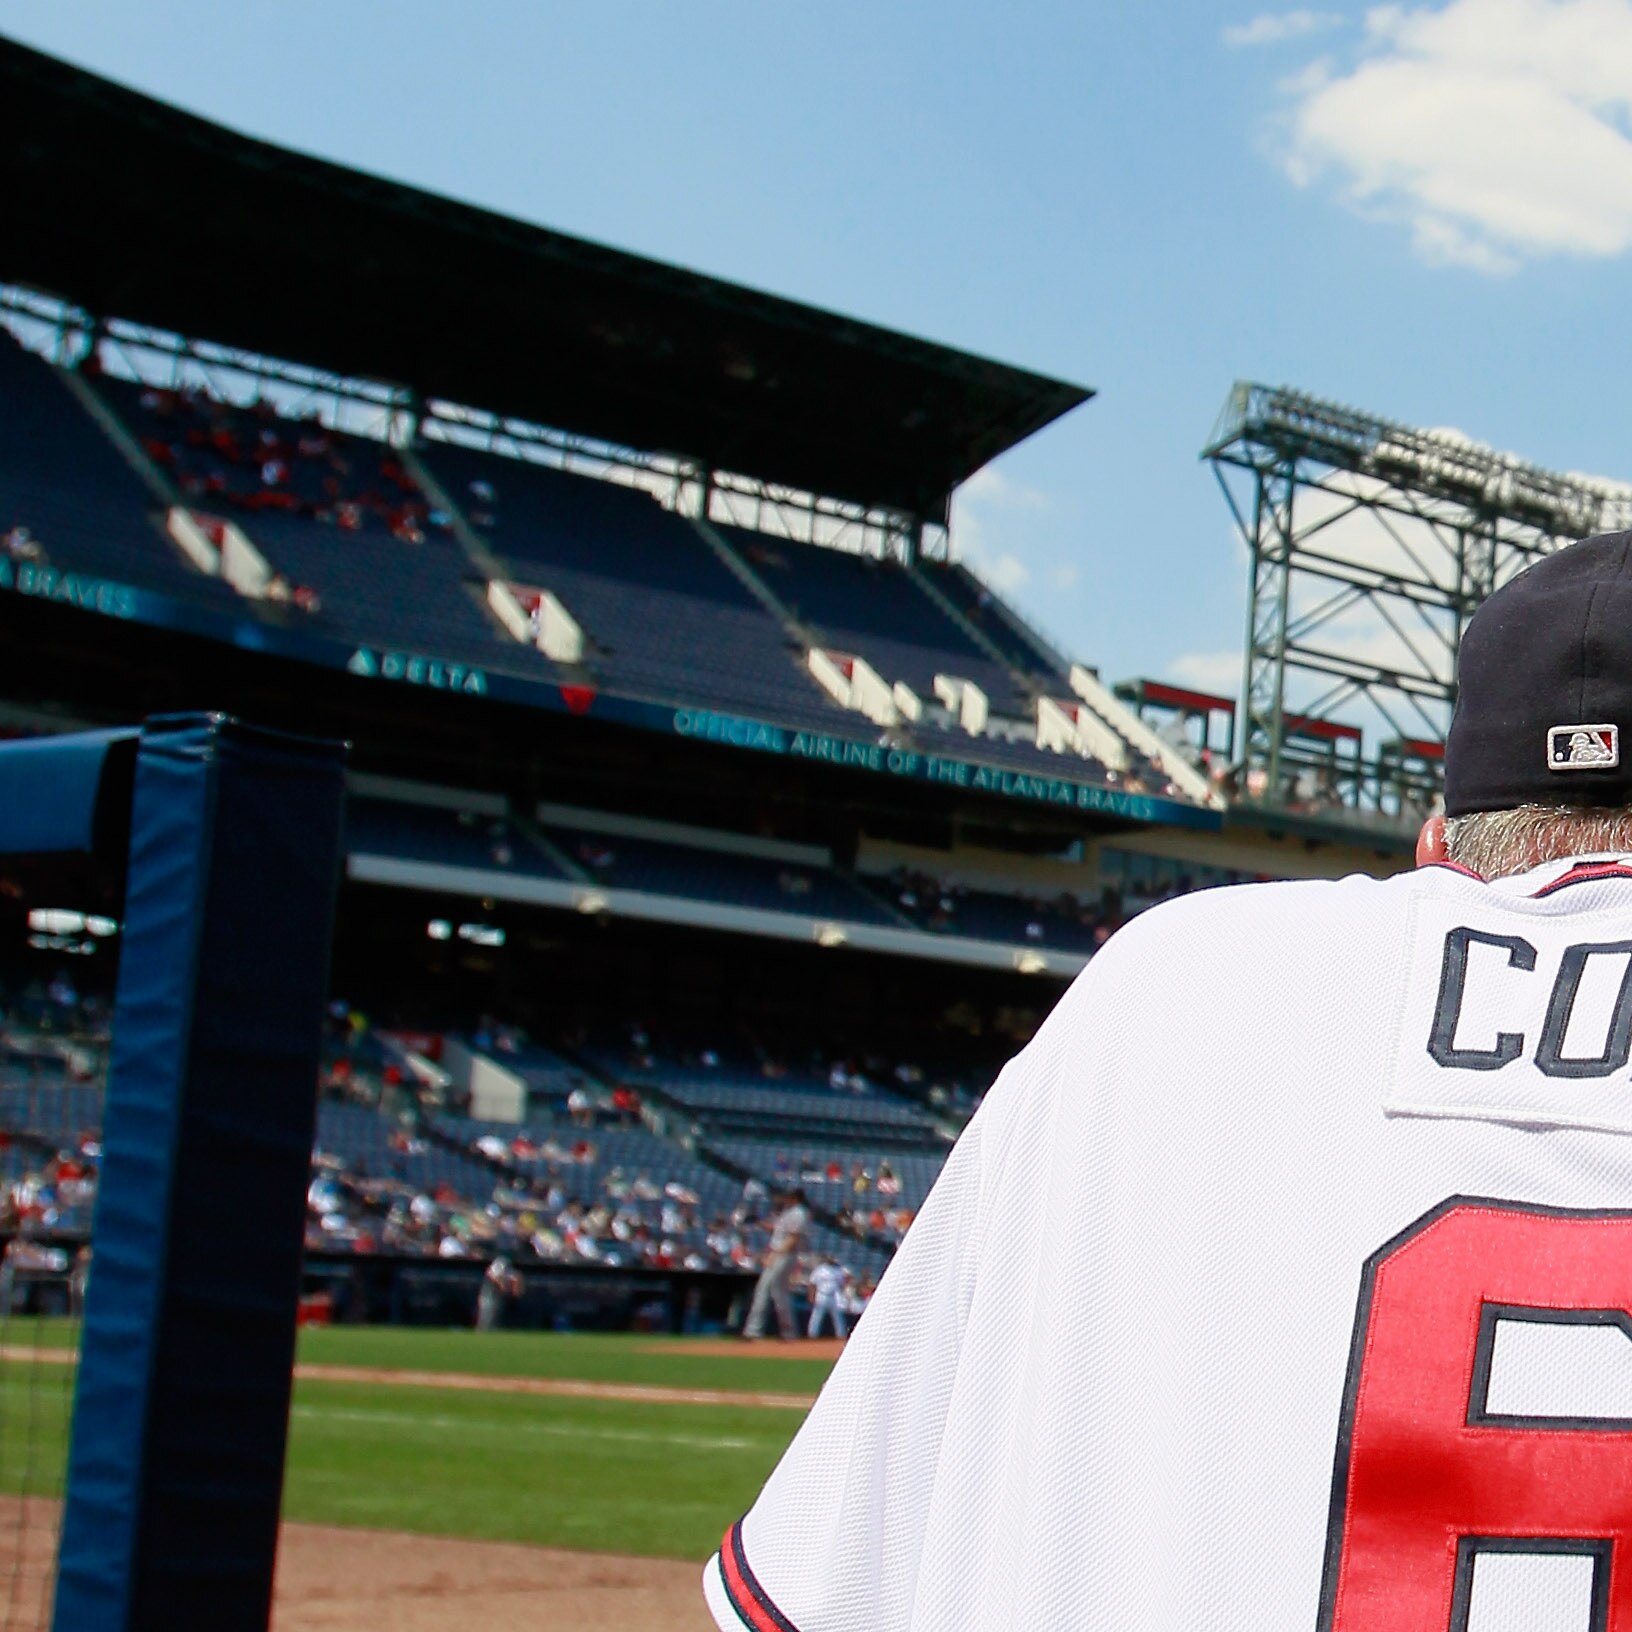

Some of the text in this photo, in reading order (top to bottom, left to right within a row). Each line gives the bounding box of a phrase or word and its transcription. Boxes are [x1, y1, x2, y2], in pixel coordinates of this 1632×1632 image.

[17, 561, 137, 620] BRAVES
[381, 652, 488, 696] DELTA
[673, 708, 1152, 820] OFFICIAL AIRLINE OF THE ATLANTA BRAVES
